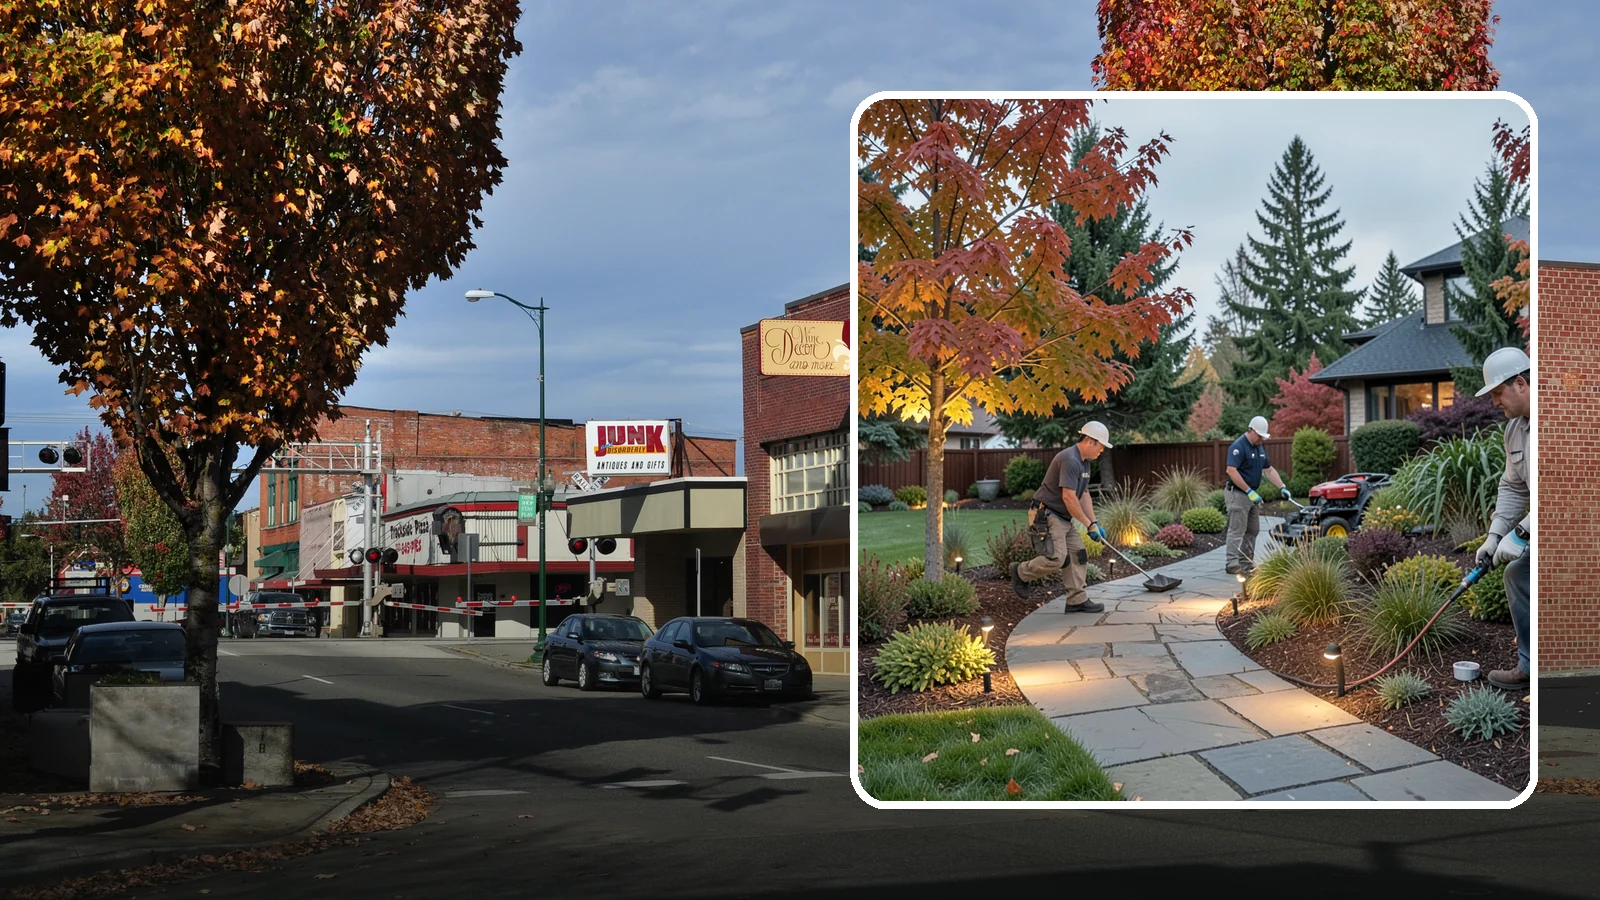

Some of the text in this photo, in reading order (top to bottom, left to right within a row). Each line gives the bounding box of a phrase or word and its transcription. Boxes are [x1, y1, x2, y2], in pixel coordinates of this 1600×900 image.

[595, 425, 665, 457] JUNK
[597, 460, 665, 470] ANTIQUES AND GIFTS
[390, 519, 429, 540] Trackside Pizza
